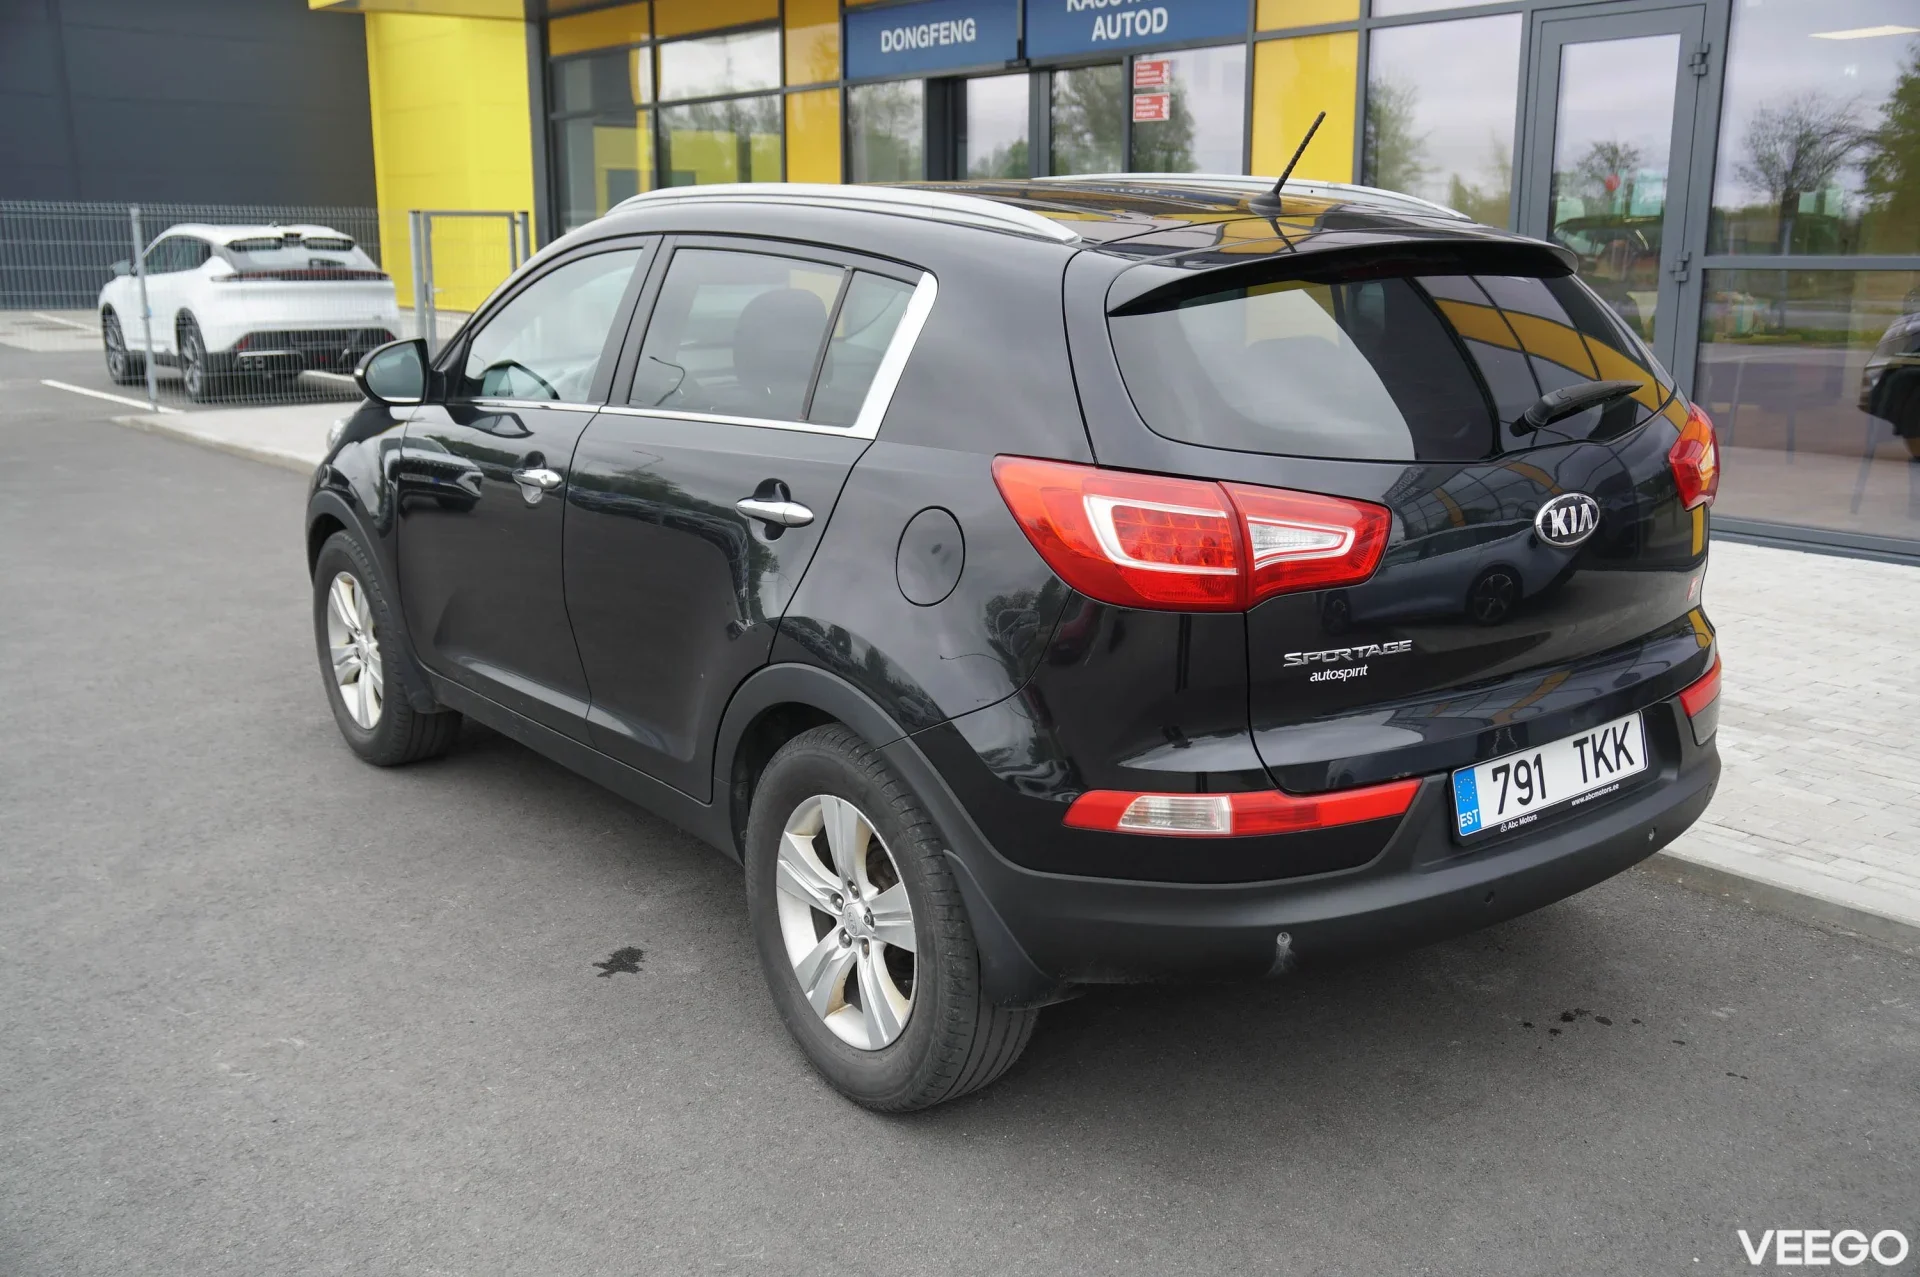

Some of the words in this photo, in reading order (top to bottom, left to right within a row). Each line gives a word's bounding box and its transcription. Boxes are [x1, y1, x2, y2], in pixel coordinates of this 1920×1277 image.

[881, 17, 976, 53] DONGFENG
[1091, 7, 1168, 42] AUTOD
[1550, 503, 1594, 537] KIA
[1283, 640, 1412, 667] SPORTAGE
[1310, 664, 1368, 682] autospirit
[1492, 753, 1547, 815] 791
[1573, 721, 1635, 783] TKK
[1571, 783, 1619, 806] www.abcmotors.ee
[1460, 809, 1479, 828] EST
[1508, 821, 1518, 830] Abc
[1519, 814, 1538, 826] Motors
